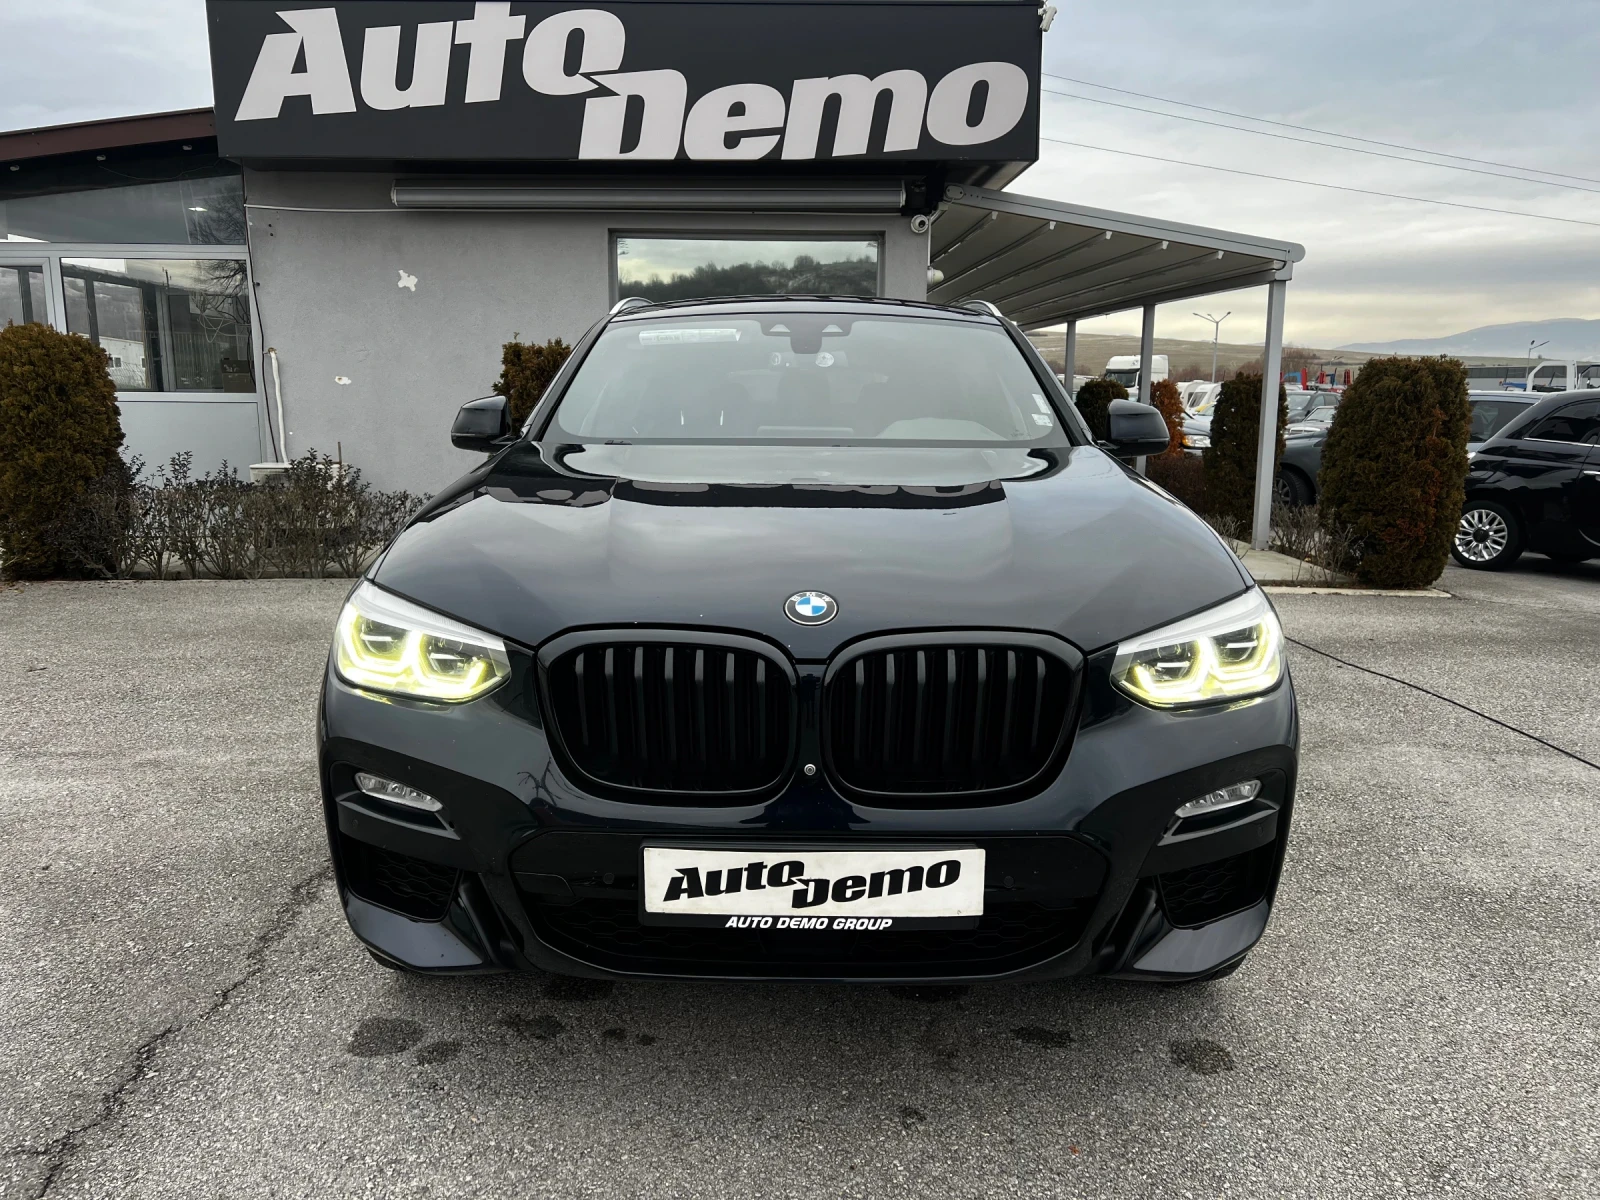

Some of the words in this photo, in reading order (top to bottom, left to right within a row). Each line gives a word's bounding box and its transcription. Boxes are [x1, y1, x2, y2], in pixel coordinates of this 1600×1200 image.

[235, 1, 626, 121] Auto
[577, 62, 1028, 160] Demo
[790, 591, 832, 601] BMW
[663, 860, 805, 902] Auto
[791, 860, 961, 909] Demo
[725, 916, 773, 929] AUTO
[776, 917, 829, 930] DEMO
[832, 918, 893, 931] GROUP
